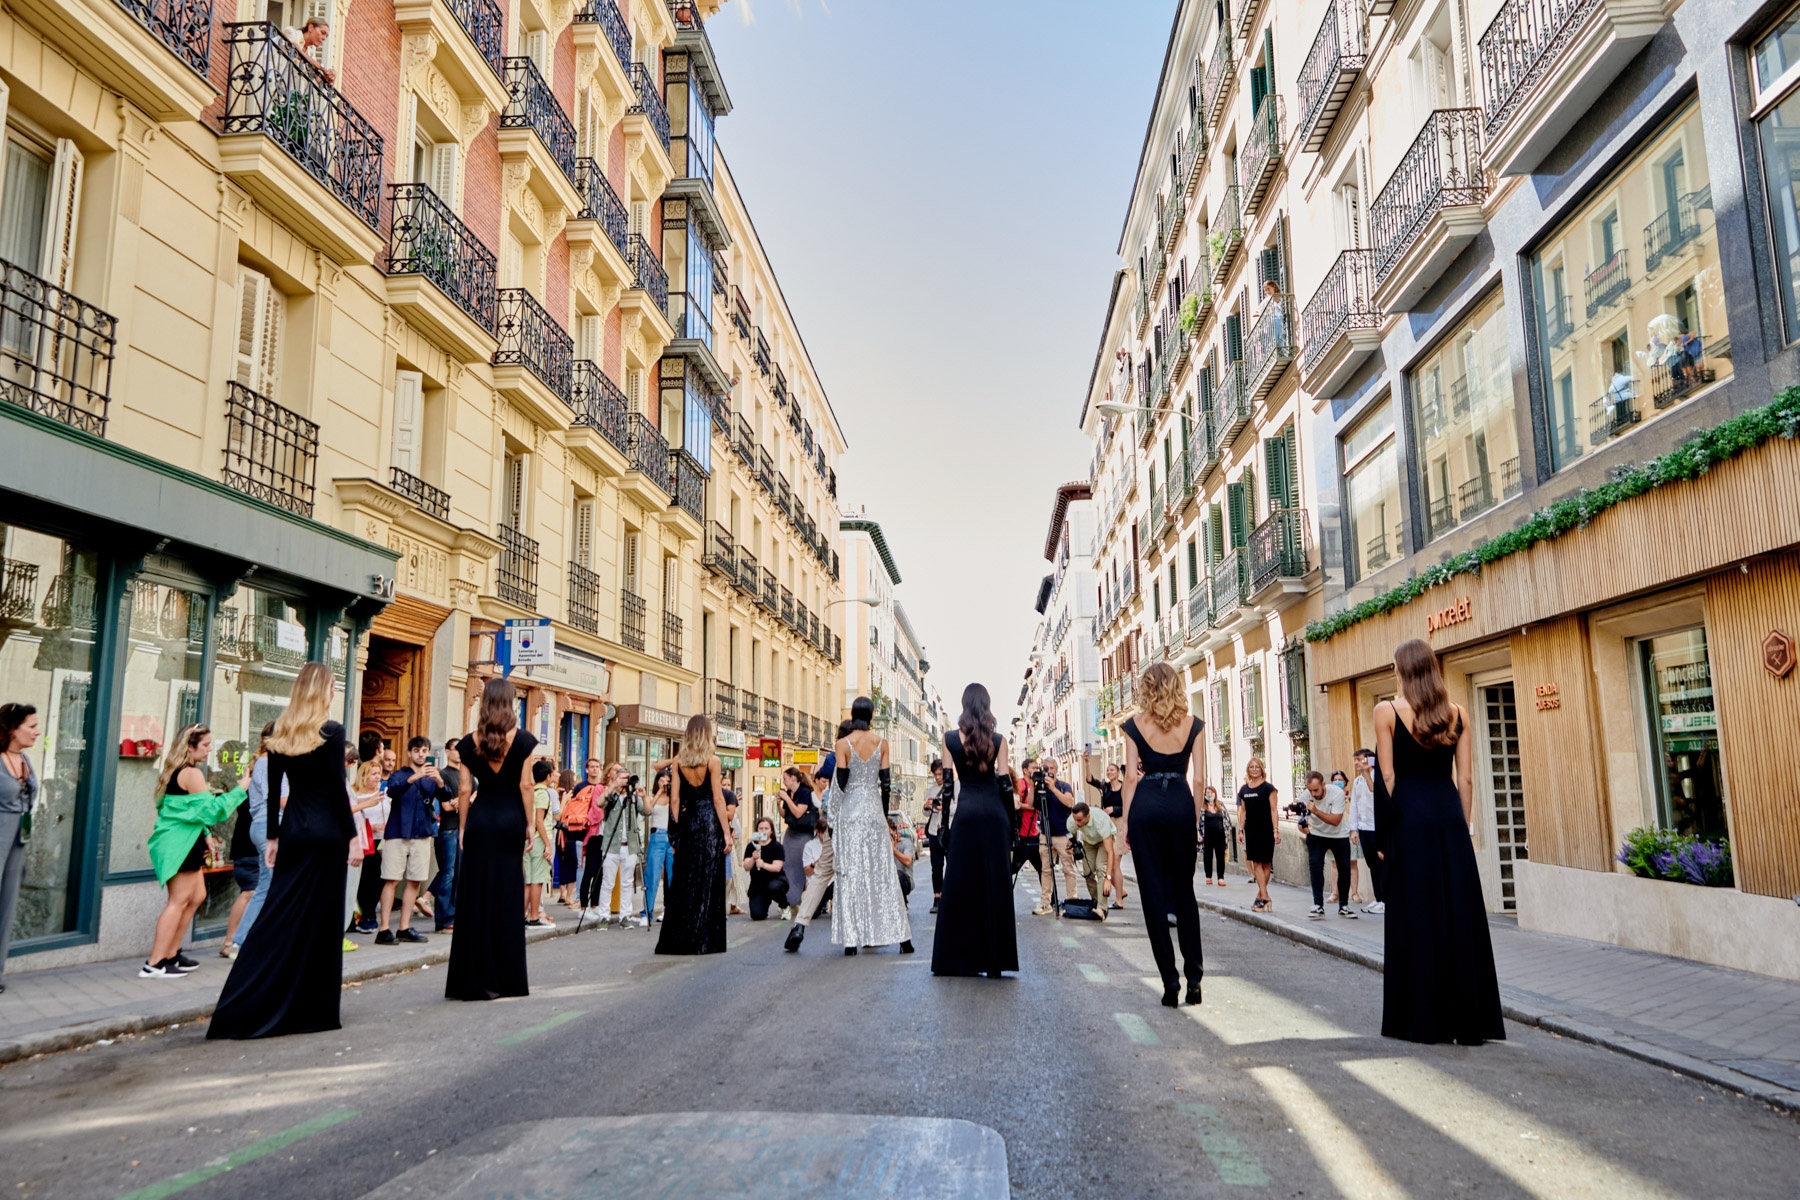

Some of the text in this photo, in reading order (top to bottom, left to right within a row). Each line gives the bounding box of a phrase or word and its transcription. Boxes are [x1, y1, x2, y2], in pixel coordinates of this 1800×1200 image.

[371, 574, 395, 598] 30
[1427, 596, 1472, 638] poncelet
[1662, 661, 1711, 689] poncelet
[1535, 683, 1558, 697] TIENDA
[1536, 698, 1560, 711] QUESOS
